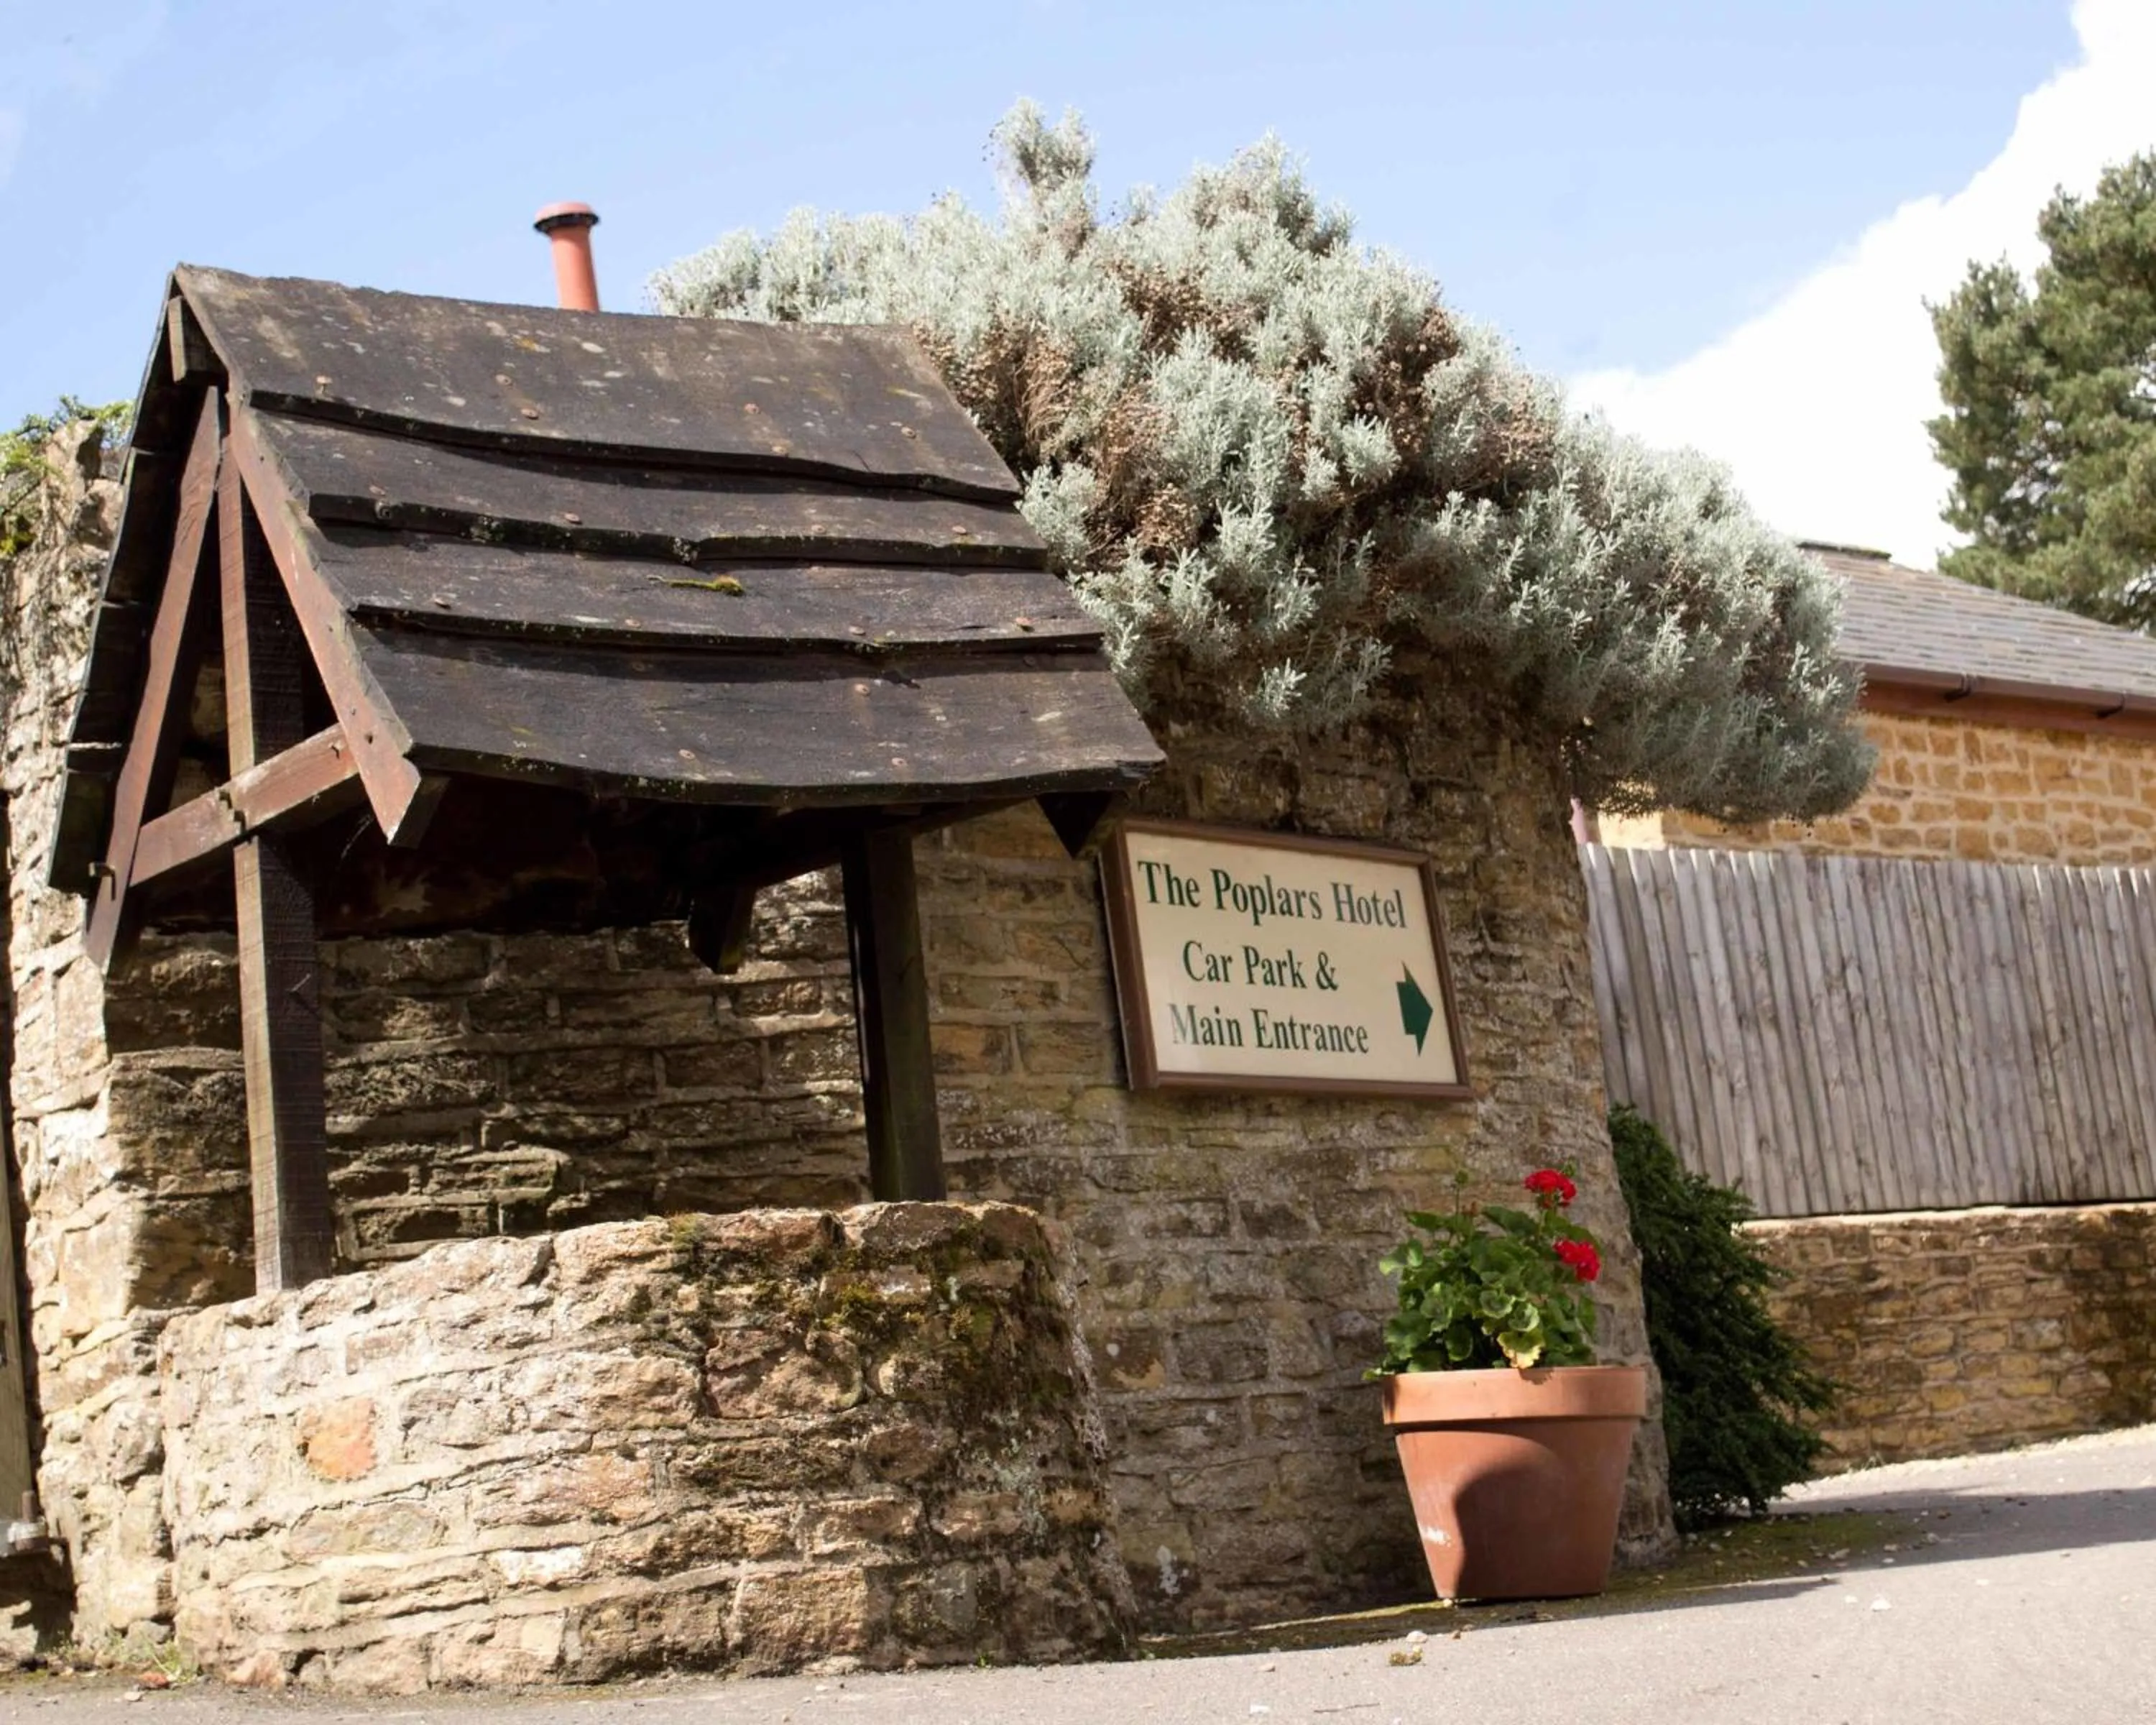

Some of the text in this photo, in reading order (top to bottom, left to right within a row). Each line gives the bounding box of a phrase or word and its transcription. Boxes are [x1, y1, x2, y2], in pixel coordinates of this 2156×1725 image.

[1138, 860, 1407, 928] The Poplars Hotel
[1182, 940, 1339, 992] Car Park &
[1169, 1003, 1370, 1054] Main Entrance
